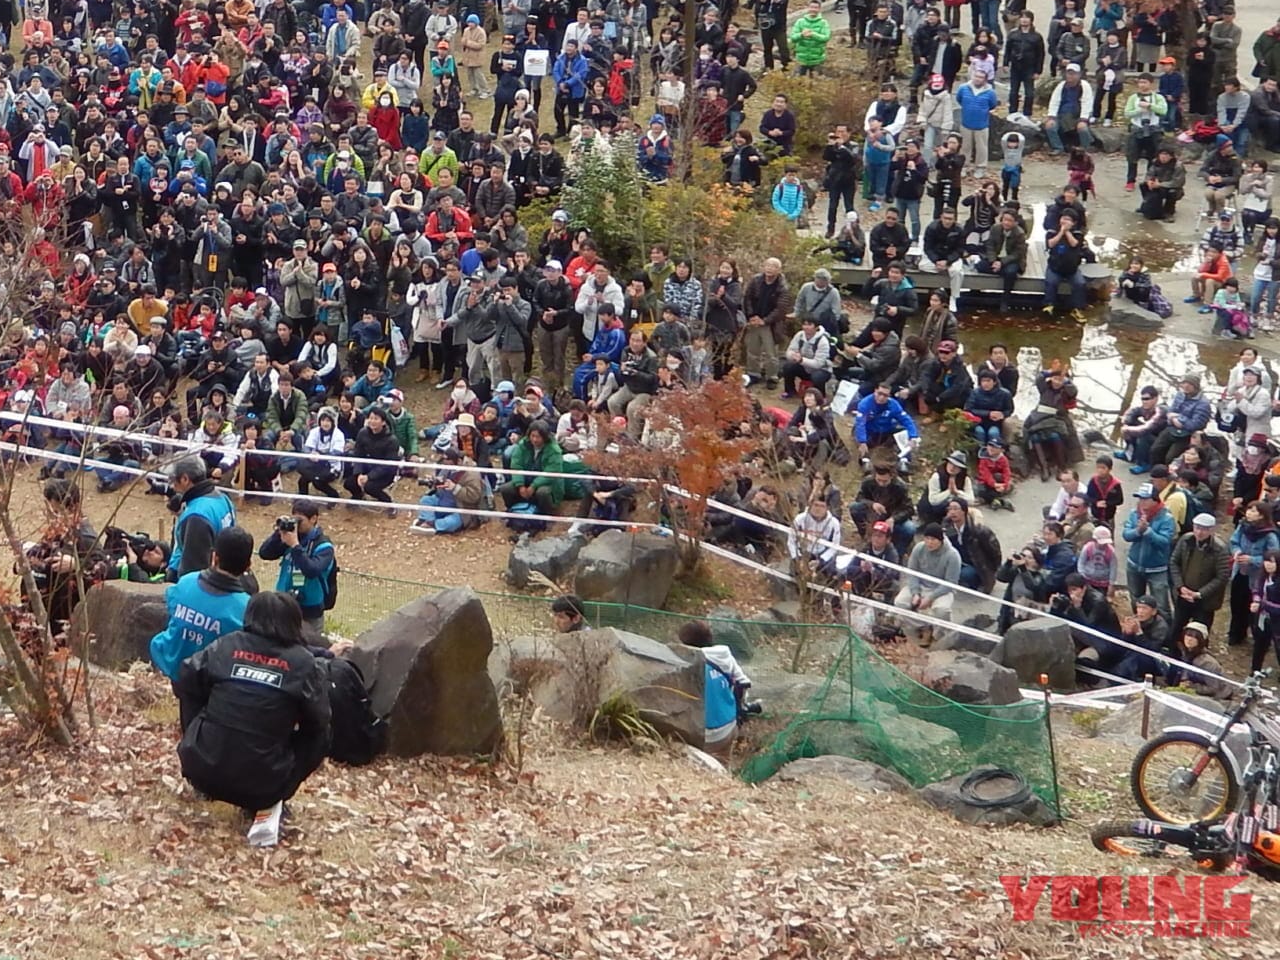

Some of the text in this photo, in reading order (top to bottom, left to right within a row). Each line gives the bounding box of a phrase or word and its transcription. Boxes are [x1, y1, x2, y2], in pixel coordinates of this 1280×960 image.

[174, 604, 220, 635] MEDIA
[182, 628, 204, 645] 198
[232, 650, 290, 671] HONDA
[235, 667, 278, 683] STAFF
